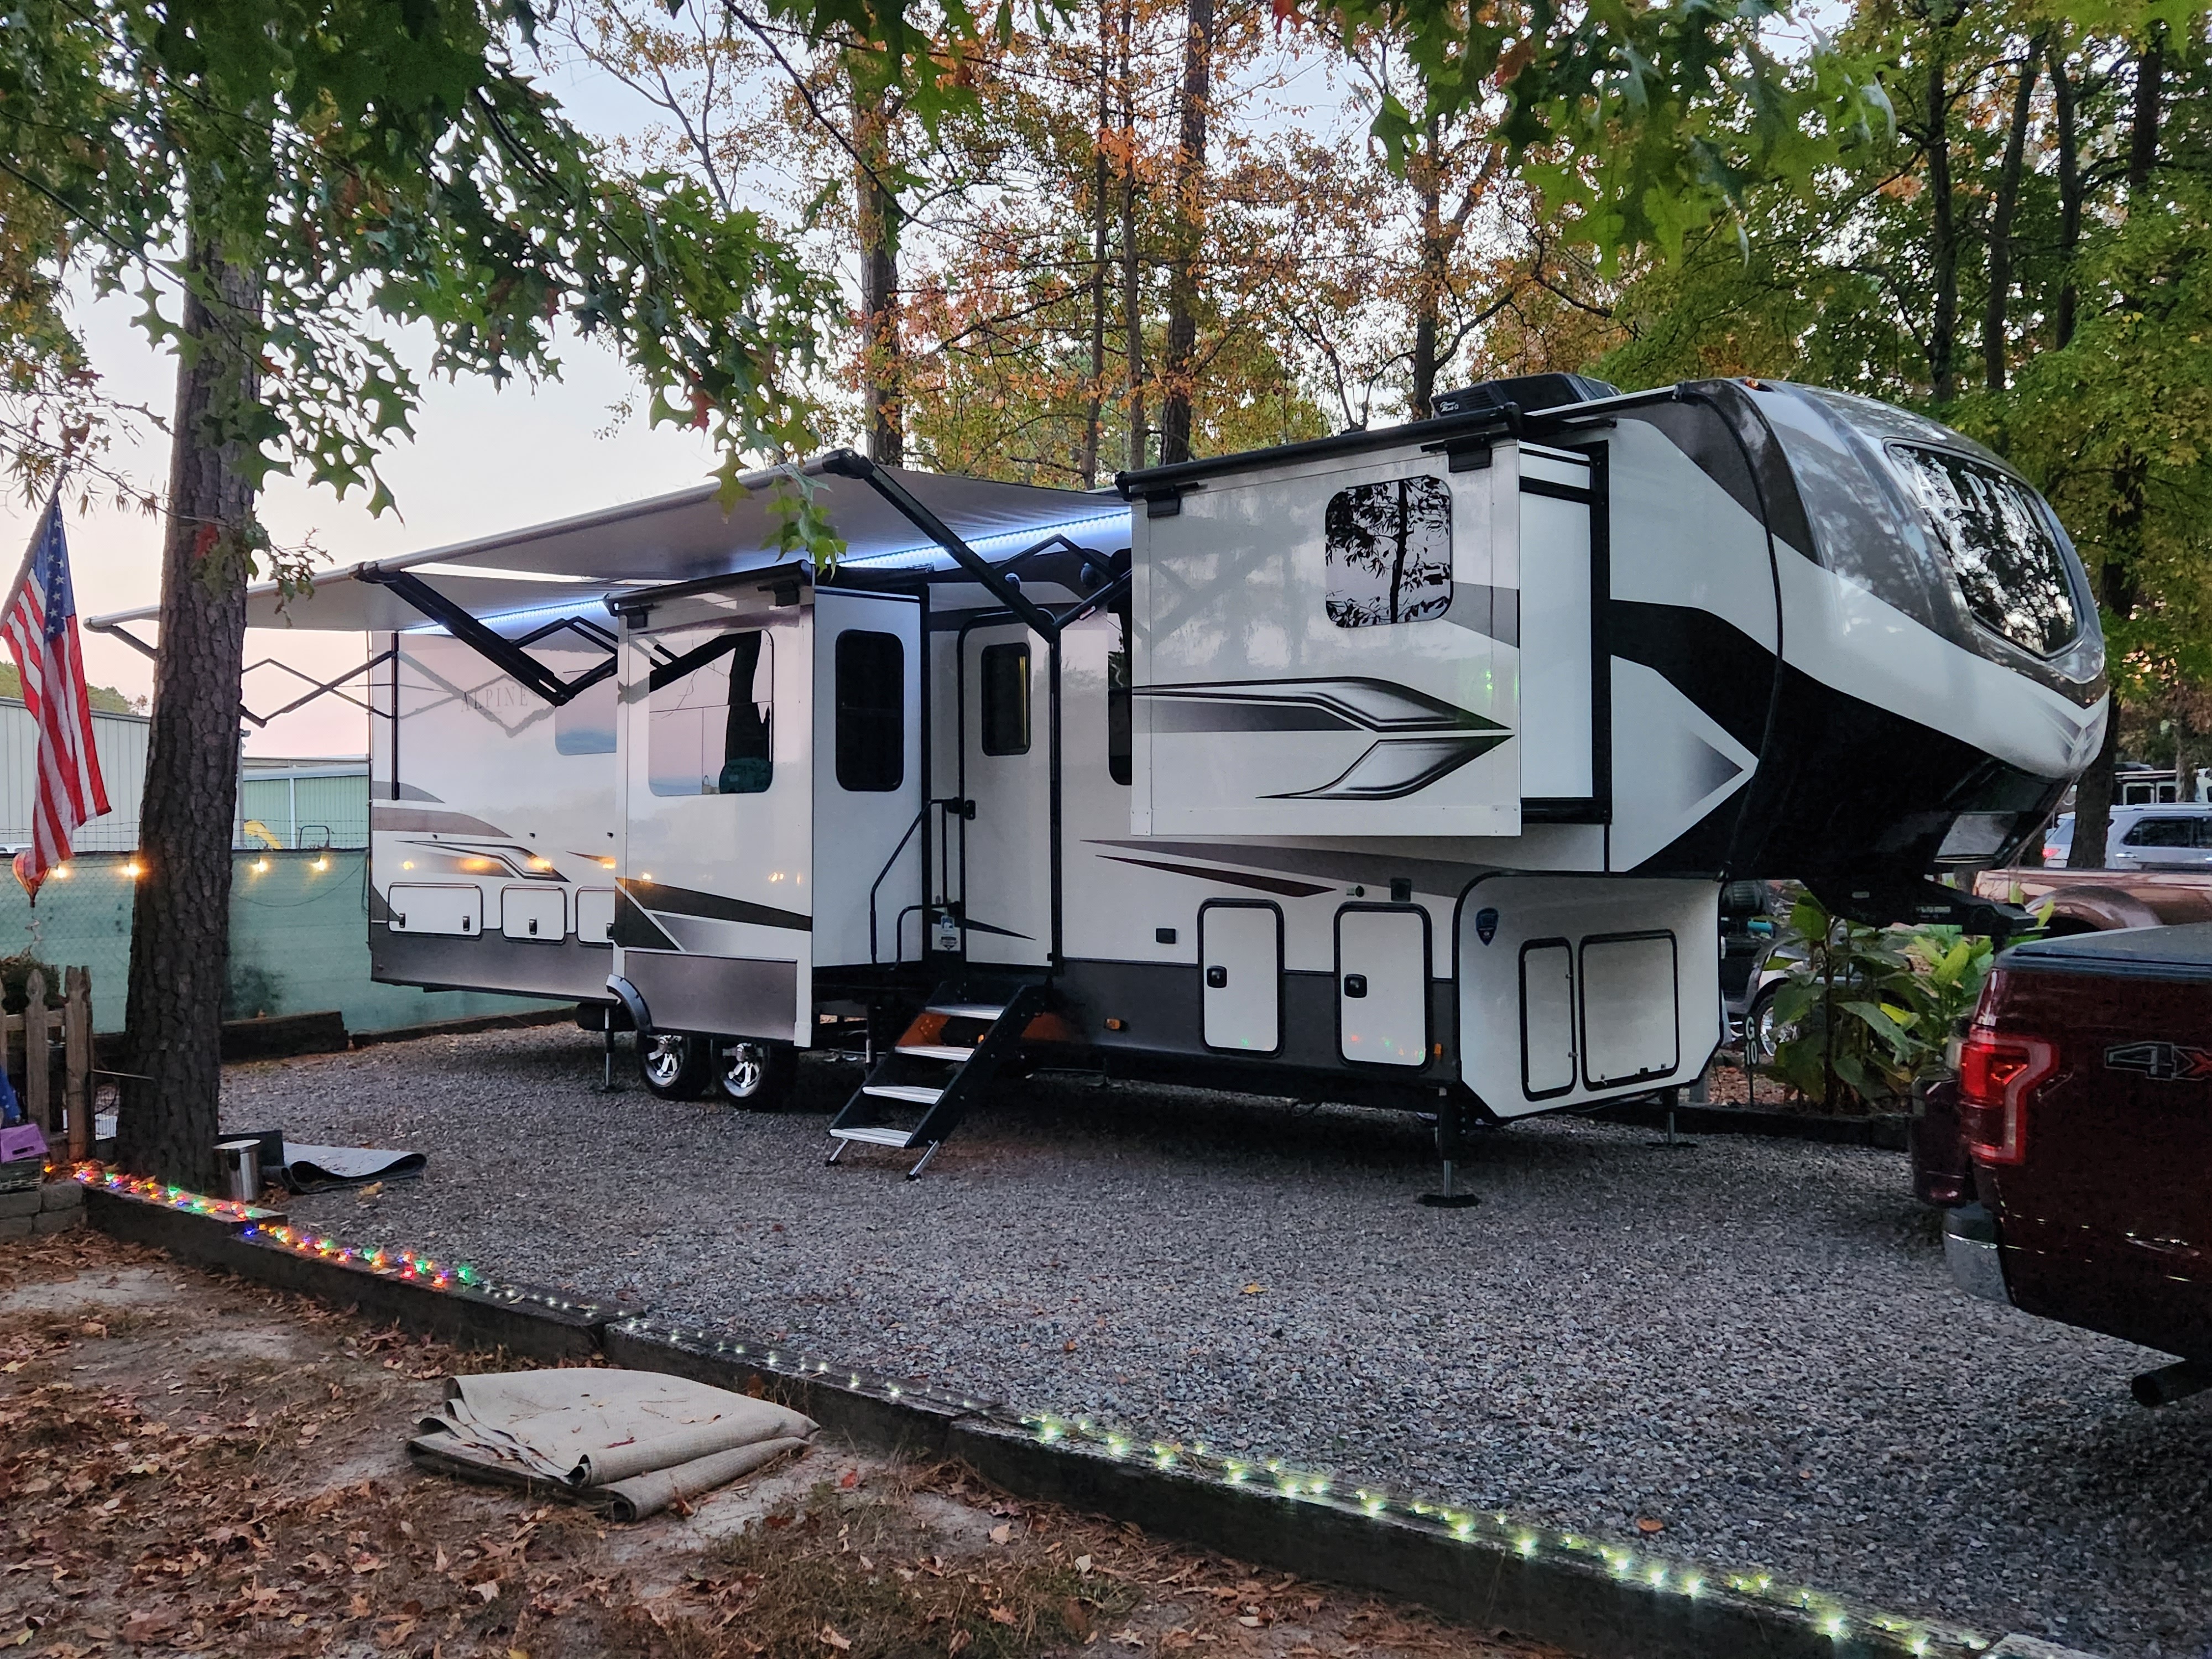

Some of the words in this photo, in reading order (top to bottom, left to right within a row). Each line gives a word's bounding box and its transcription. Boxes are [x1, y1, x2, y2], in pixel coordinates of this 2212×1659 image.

[1912, 462, 2053, 534] ALPINE
[460, 685, 528, 713] ALPINE
[1745, 1016, 1755, 1040] G
[1745, 1040, 1758, 1066] 10
